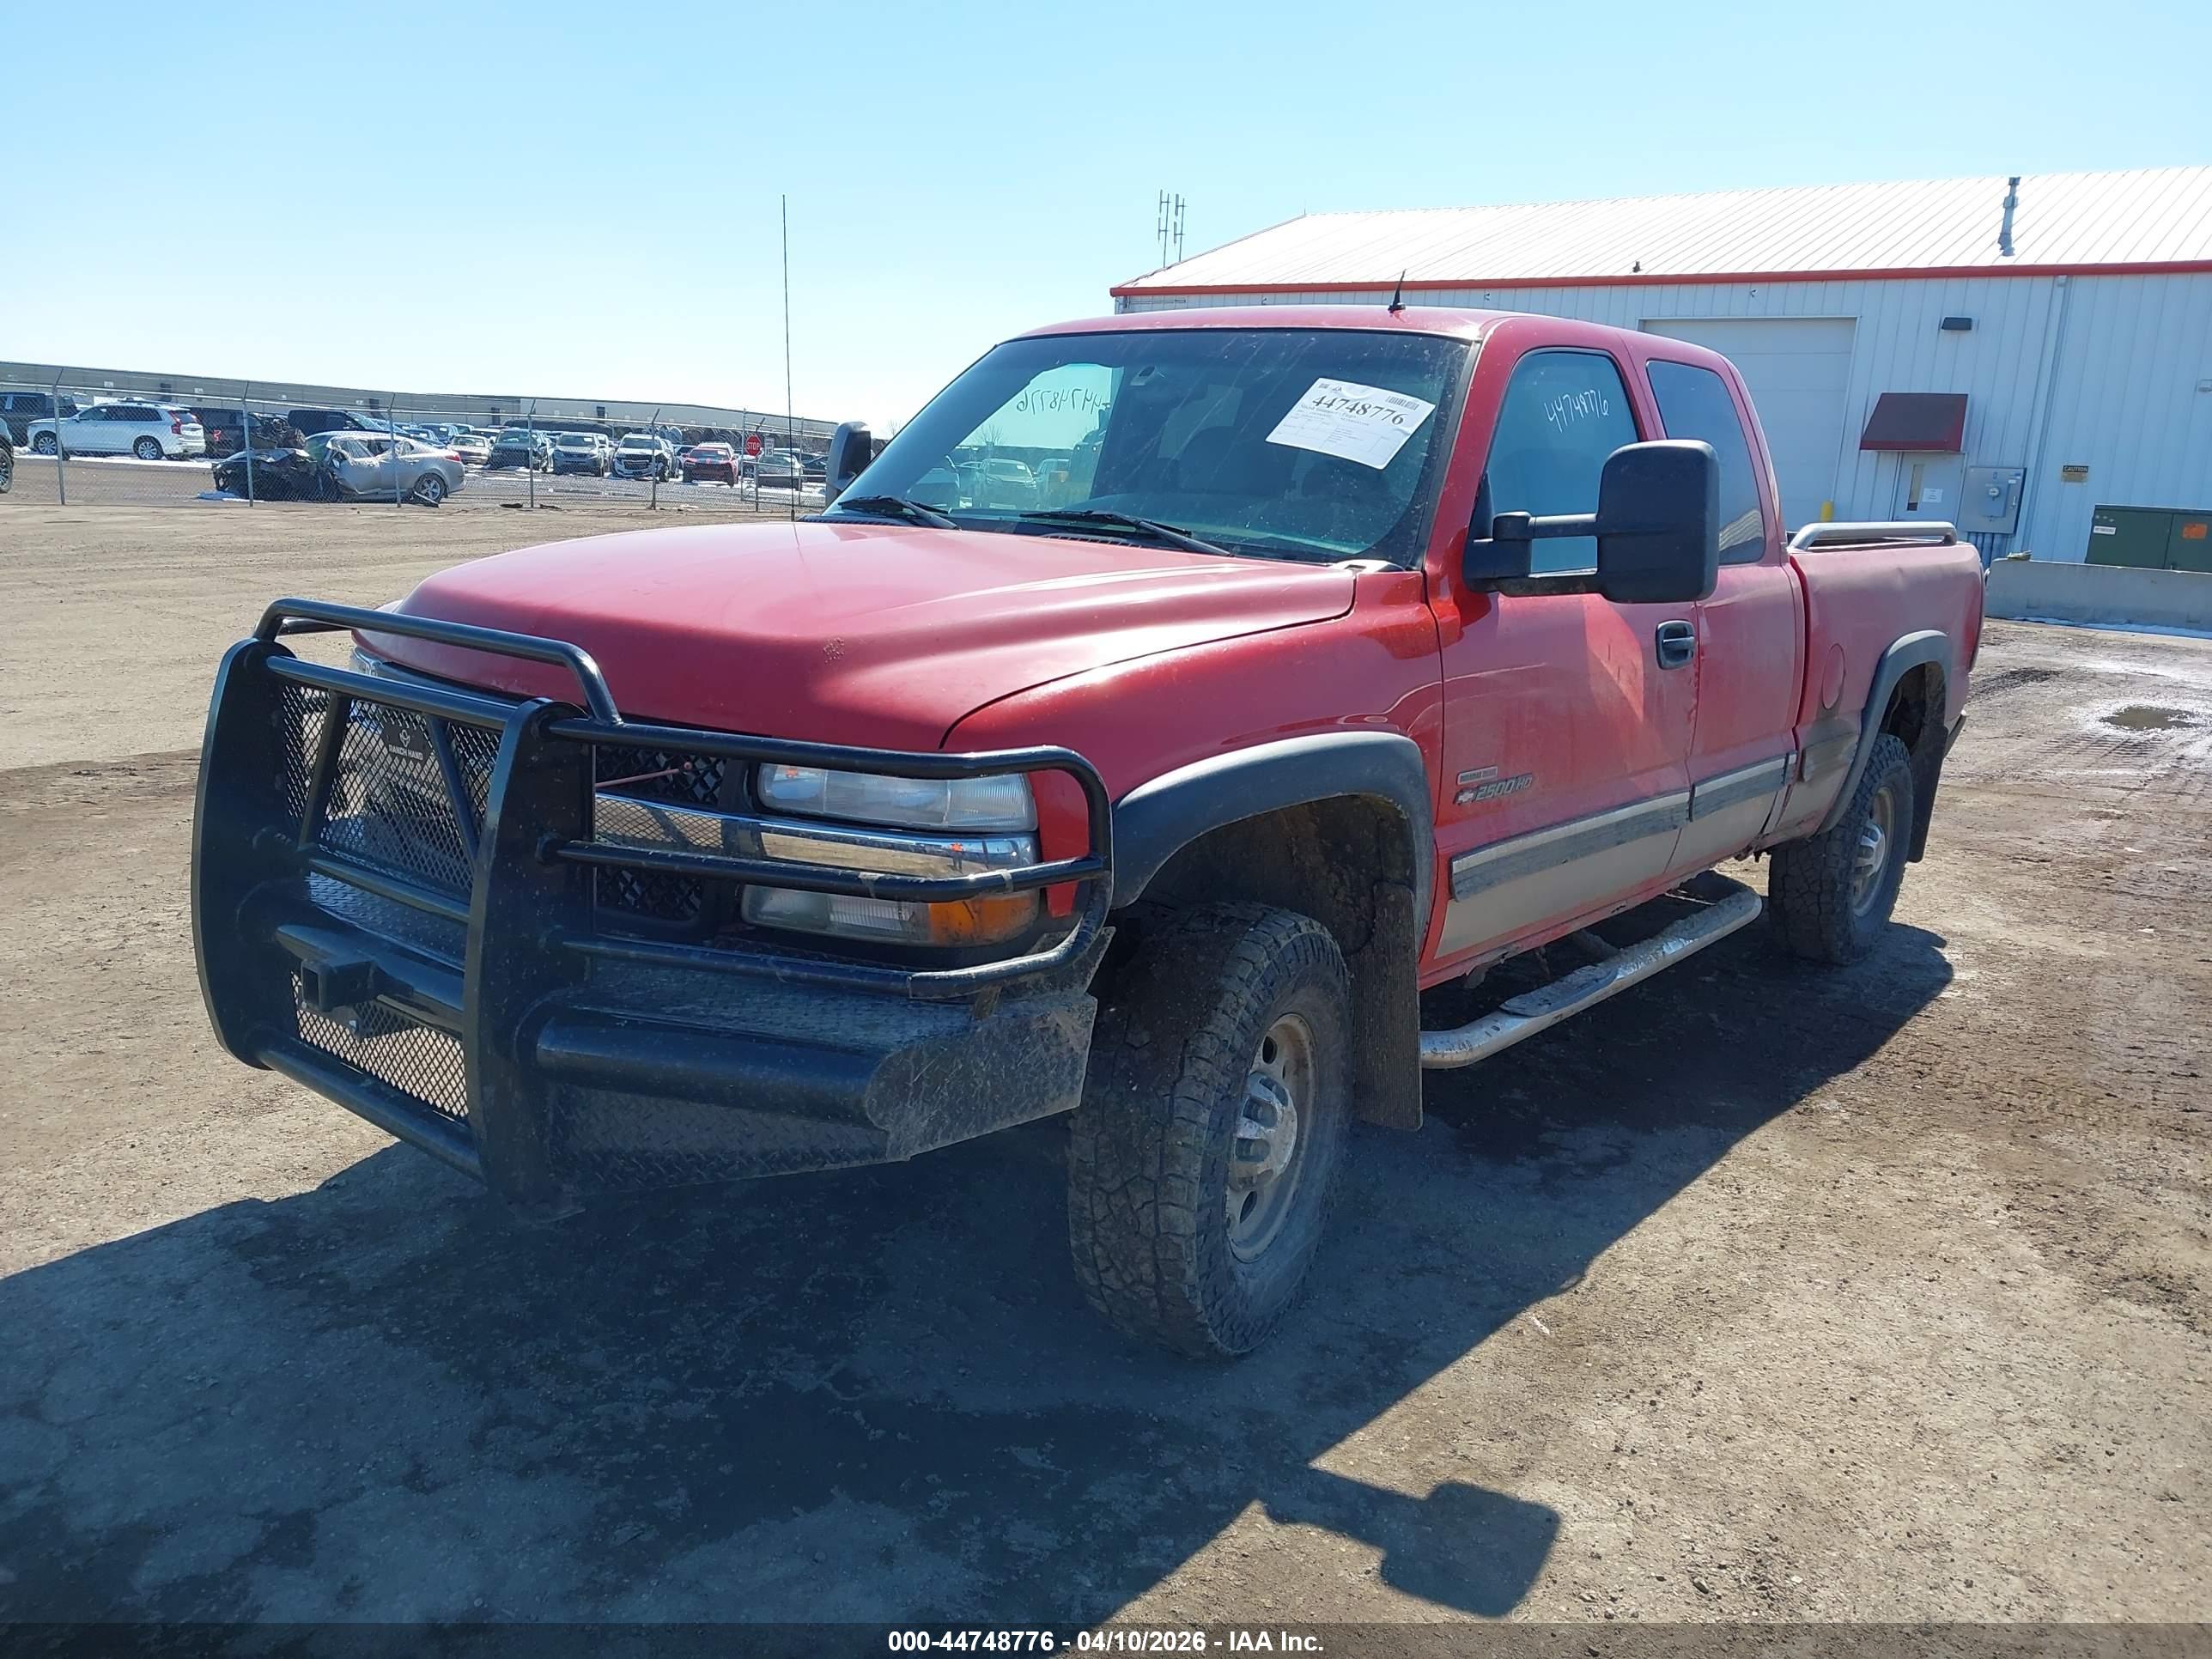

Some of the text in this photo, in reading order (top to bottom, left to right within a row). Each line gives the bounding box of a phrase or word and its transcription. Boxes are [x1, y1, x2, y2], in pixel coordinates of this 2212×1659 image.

[1313, 395, 1407, 425] 44748776
[747, 442, 760, 451] STOP
[388, 744, 423, 761] RANCH HAND
